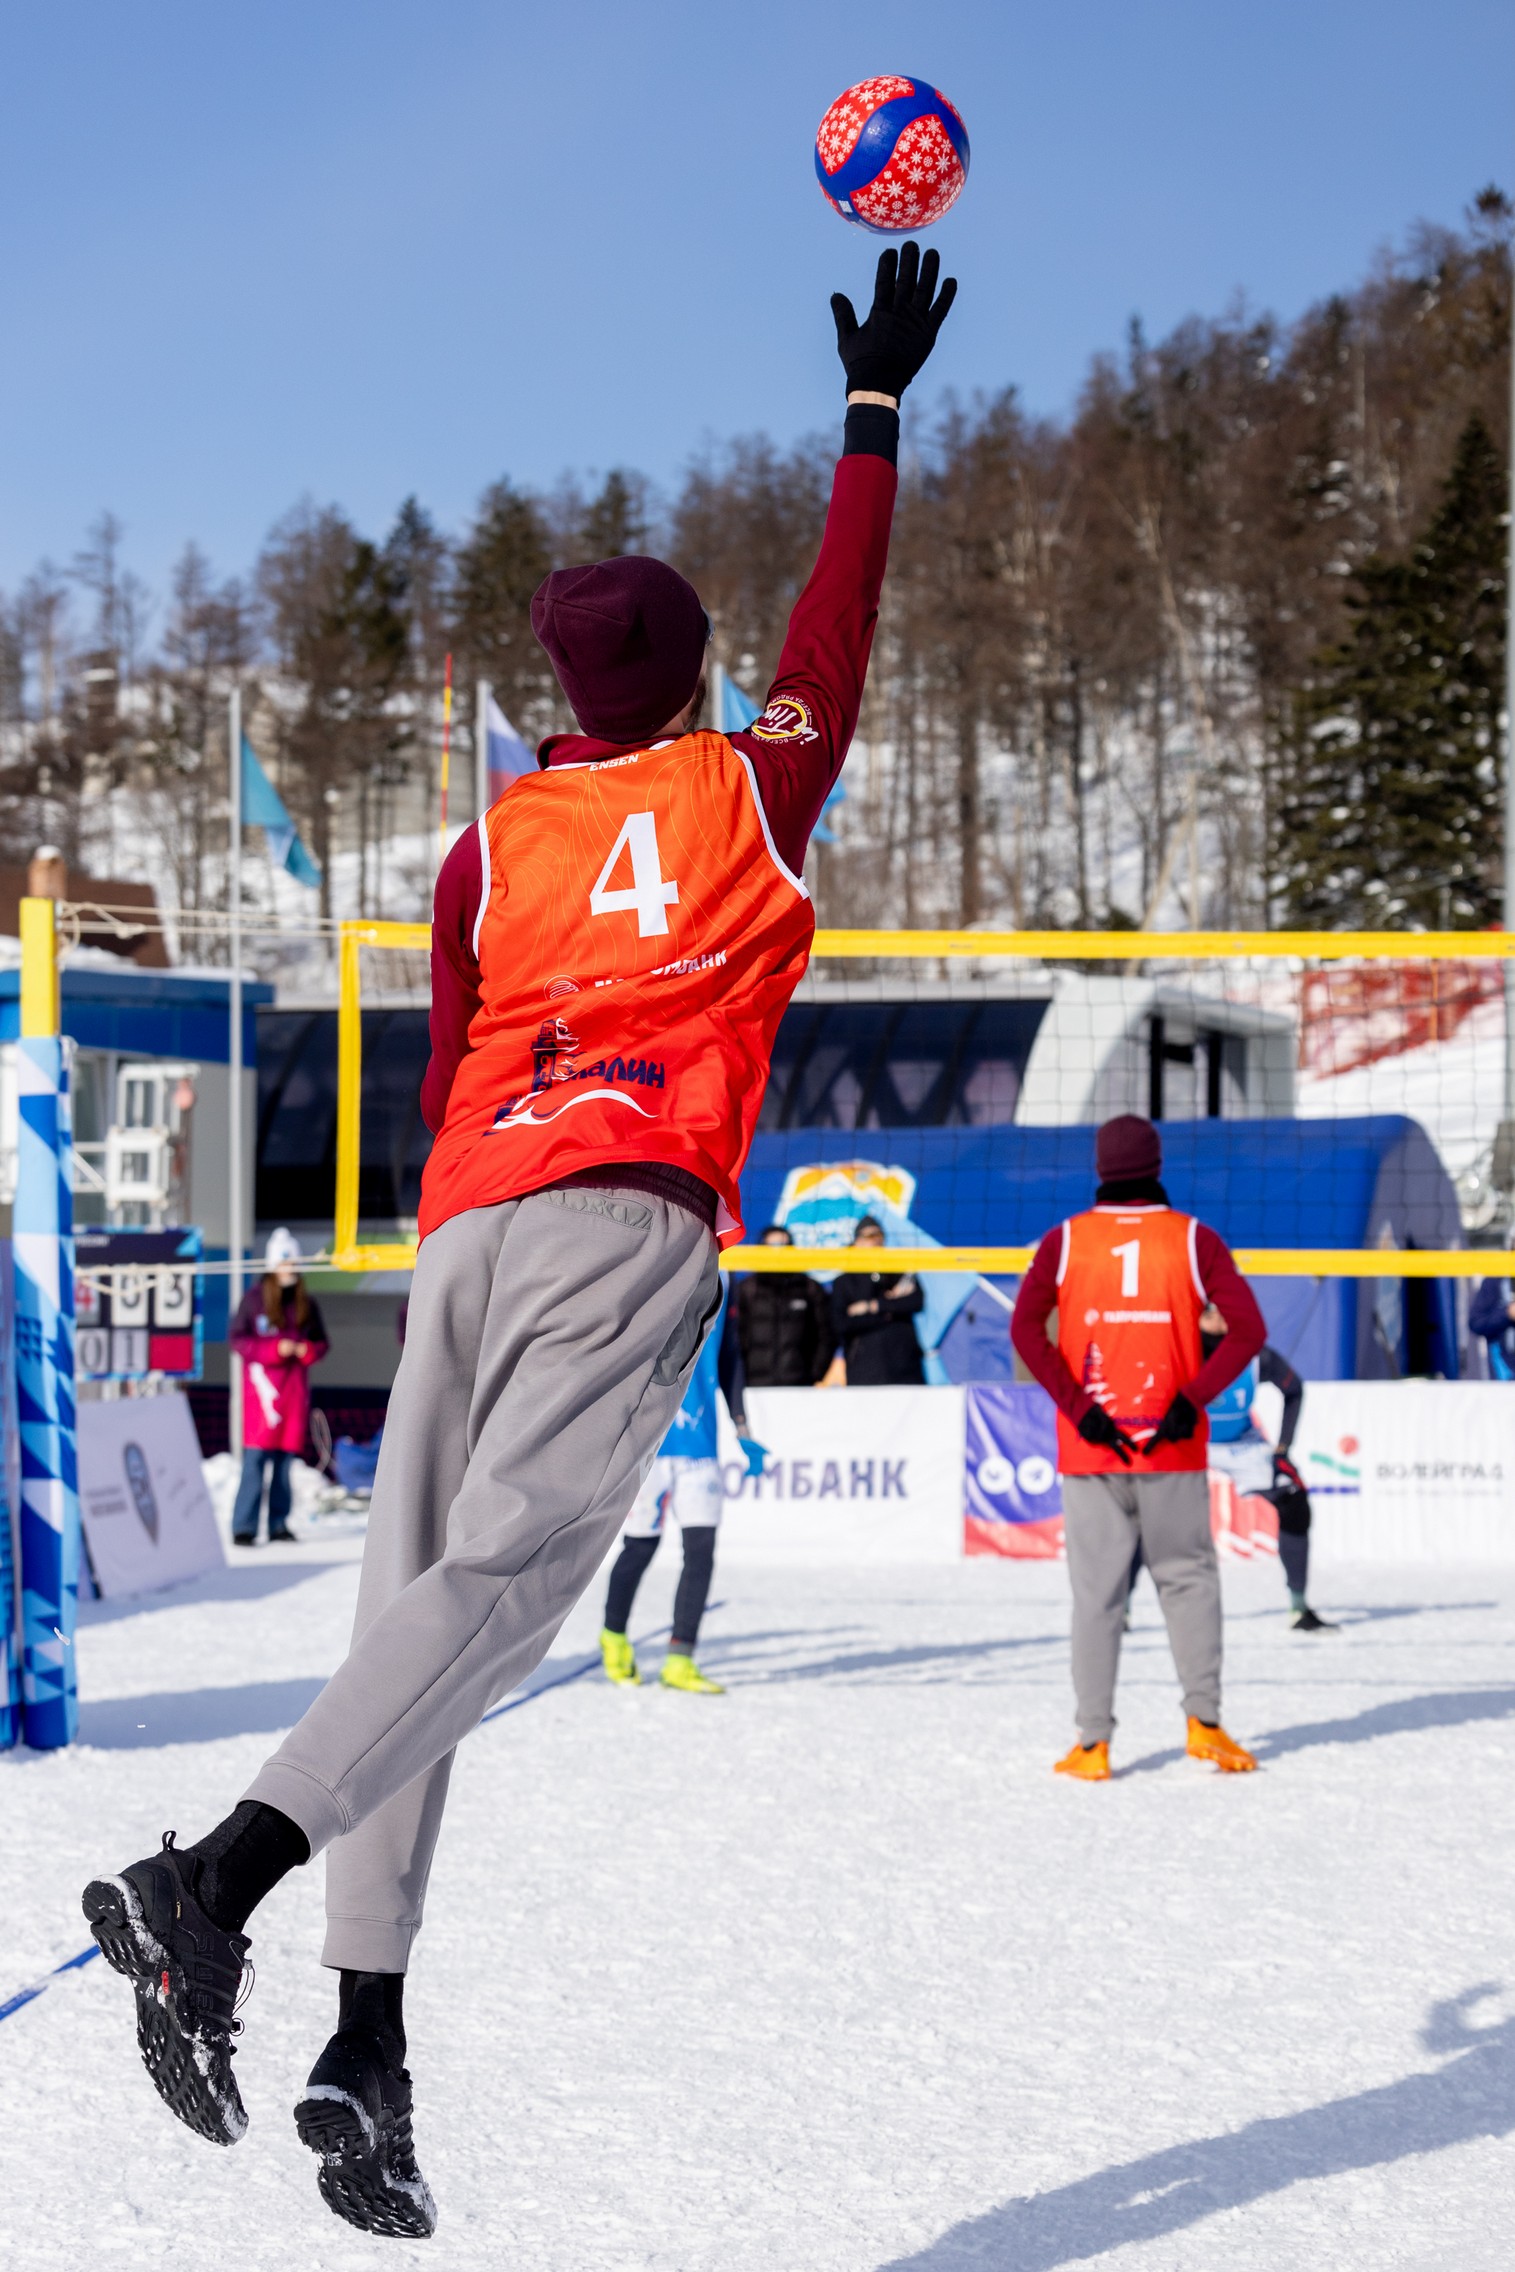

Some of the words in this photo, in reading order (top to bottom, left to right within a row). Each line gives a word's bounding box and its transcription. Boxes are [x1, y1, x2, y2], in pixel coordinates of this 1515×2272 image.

[589, 753, 640, 772] ENSEN
[589, 811, 680, 938] 4
[1111, 1239, 1140, 1297] 1
